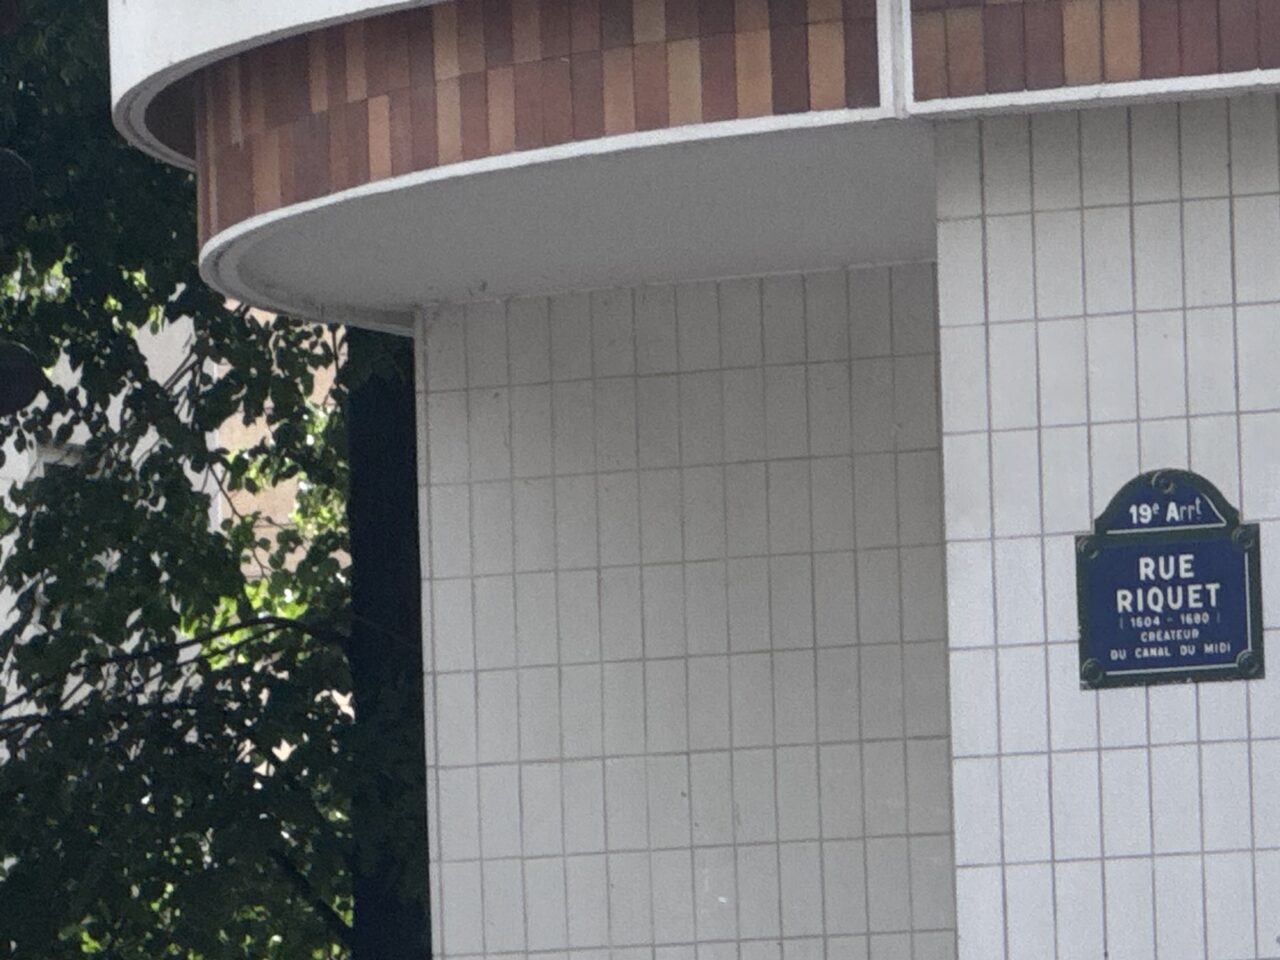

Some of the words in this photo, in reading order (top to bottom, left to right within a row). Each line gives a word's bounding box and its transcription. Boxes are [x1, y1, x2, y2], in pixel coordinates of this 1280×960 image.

[1139, 554, 1195, 581] RUE
[1116, 583, 1220, 613] RIQUET
[1141, 628, 1199, 642] CRÉATEUR
[1110, 649, 1126, 660] DU
[1135, 647, 1171, 658] CANAL
[1180, 645, 1195, 656] DU
[1204, 643, 1230, 654] MIDI
